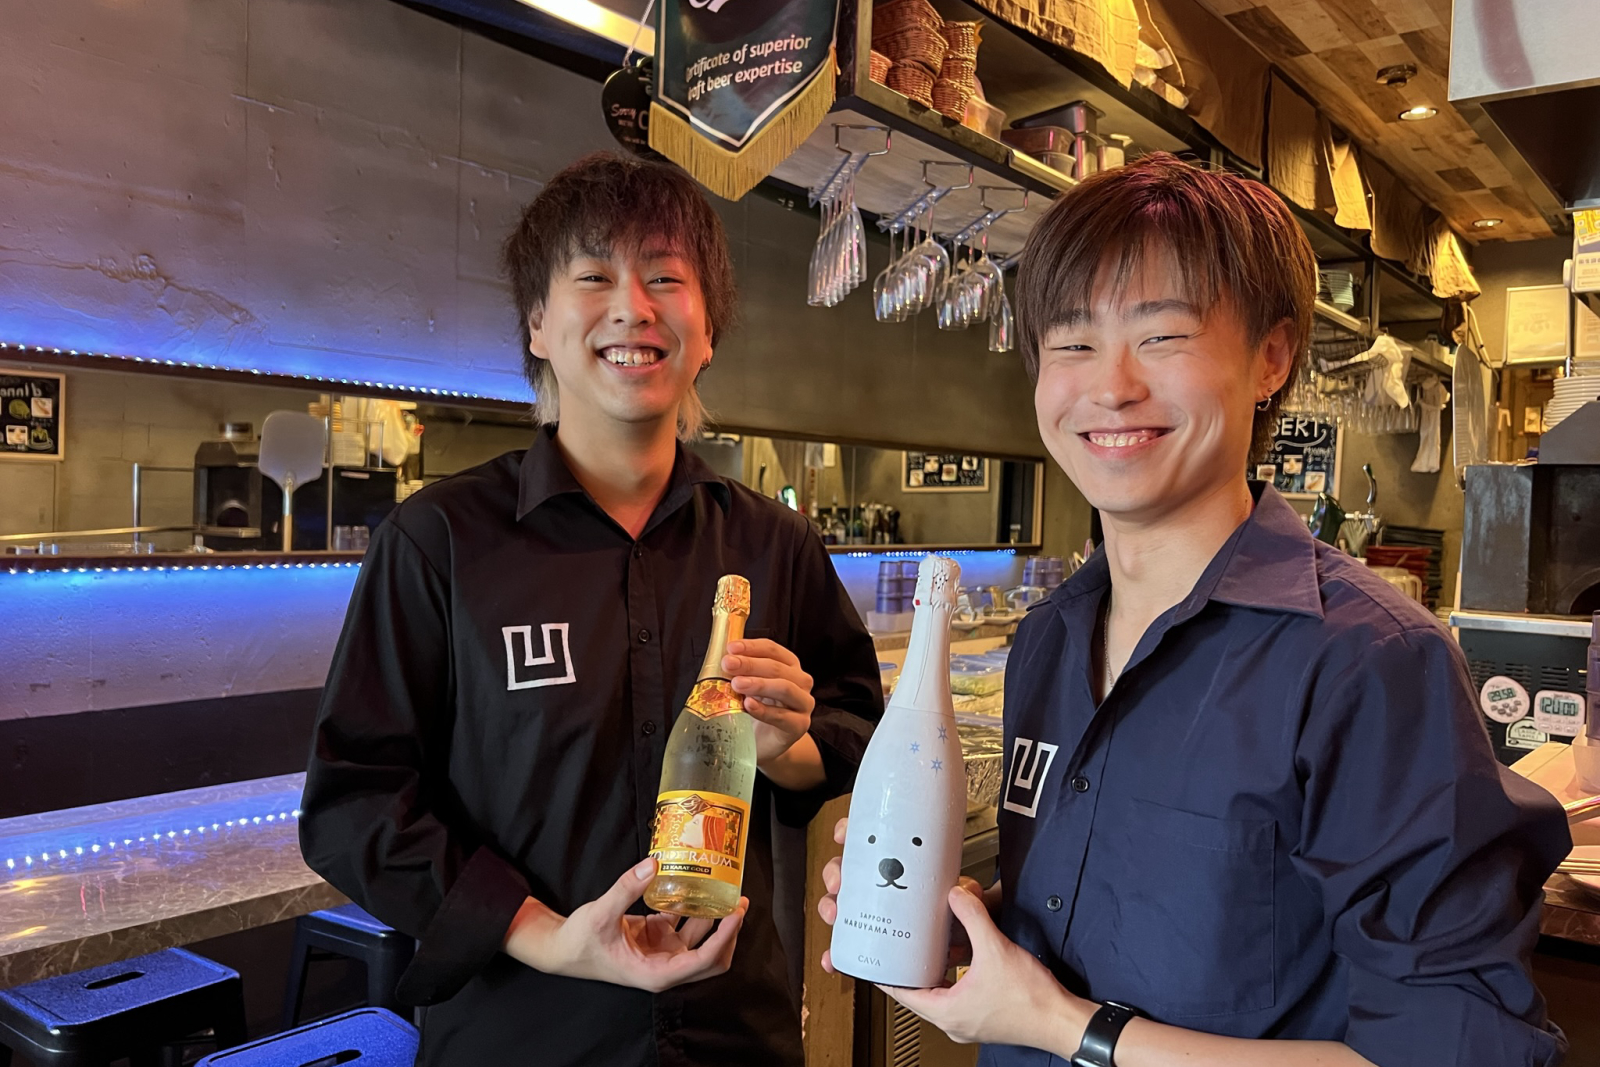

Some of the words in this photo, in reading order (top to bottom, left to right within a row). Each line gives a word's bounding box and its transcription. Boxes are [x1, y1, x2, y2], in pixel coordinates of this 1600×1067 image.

[732, 44, 749, 64] of
[749, 35, 812, 58] superior
[706, 73, 734, 92] beer
[734, 58, 803, 83] expertise
[690, 866, 710, 874] GOLD
[859, 911, 892, 925] SAPPORO
[843, 917, 888, 935] MARUYAMA
[892, 929, 912, 939] ZOO
[857, 954, 881, 967] CAVA
